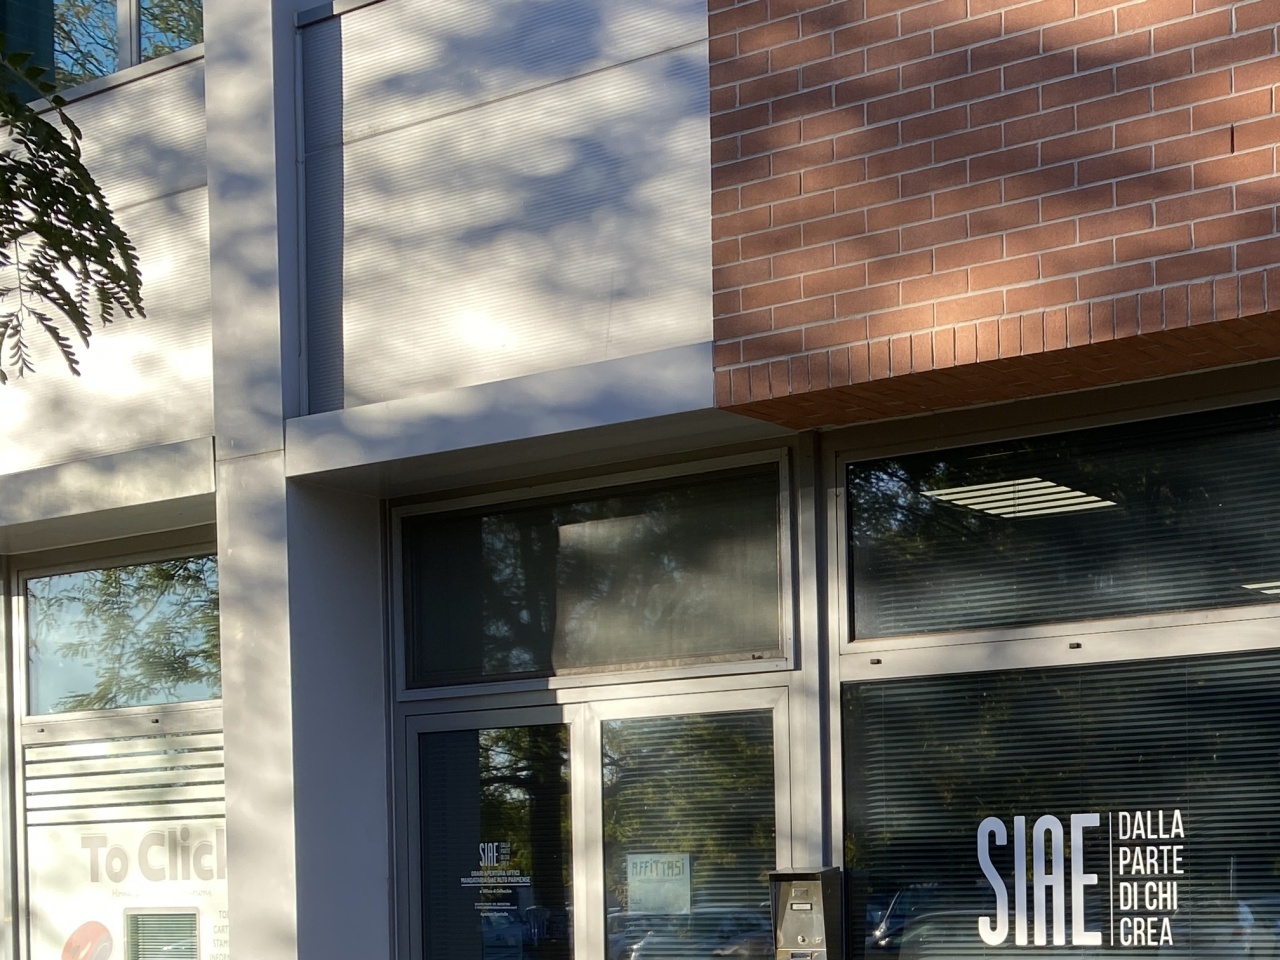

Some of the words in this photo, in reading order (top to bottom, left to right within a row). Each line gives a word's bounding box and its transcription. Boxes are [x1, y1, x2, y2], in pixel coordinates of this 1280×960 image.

[1118, 809, 1185, 840] DALLA
[81, 833, 129, 883] To
[479, 842, 499, 867] SIAE
[1118, 845, 1185, 875] PARTE
[977, 813, 1102, 946] SIAE
[1119, 882, 1138, 911] DI
[1145, 881, 1178, 911] CHI
[213, 925, 229, 934] CART
[213, 939, 229, 948] STAM
[1119, 917, 1174, 946] CREA
